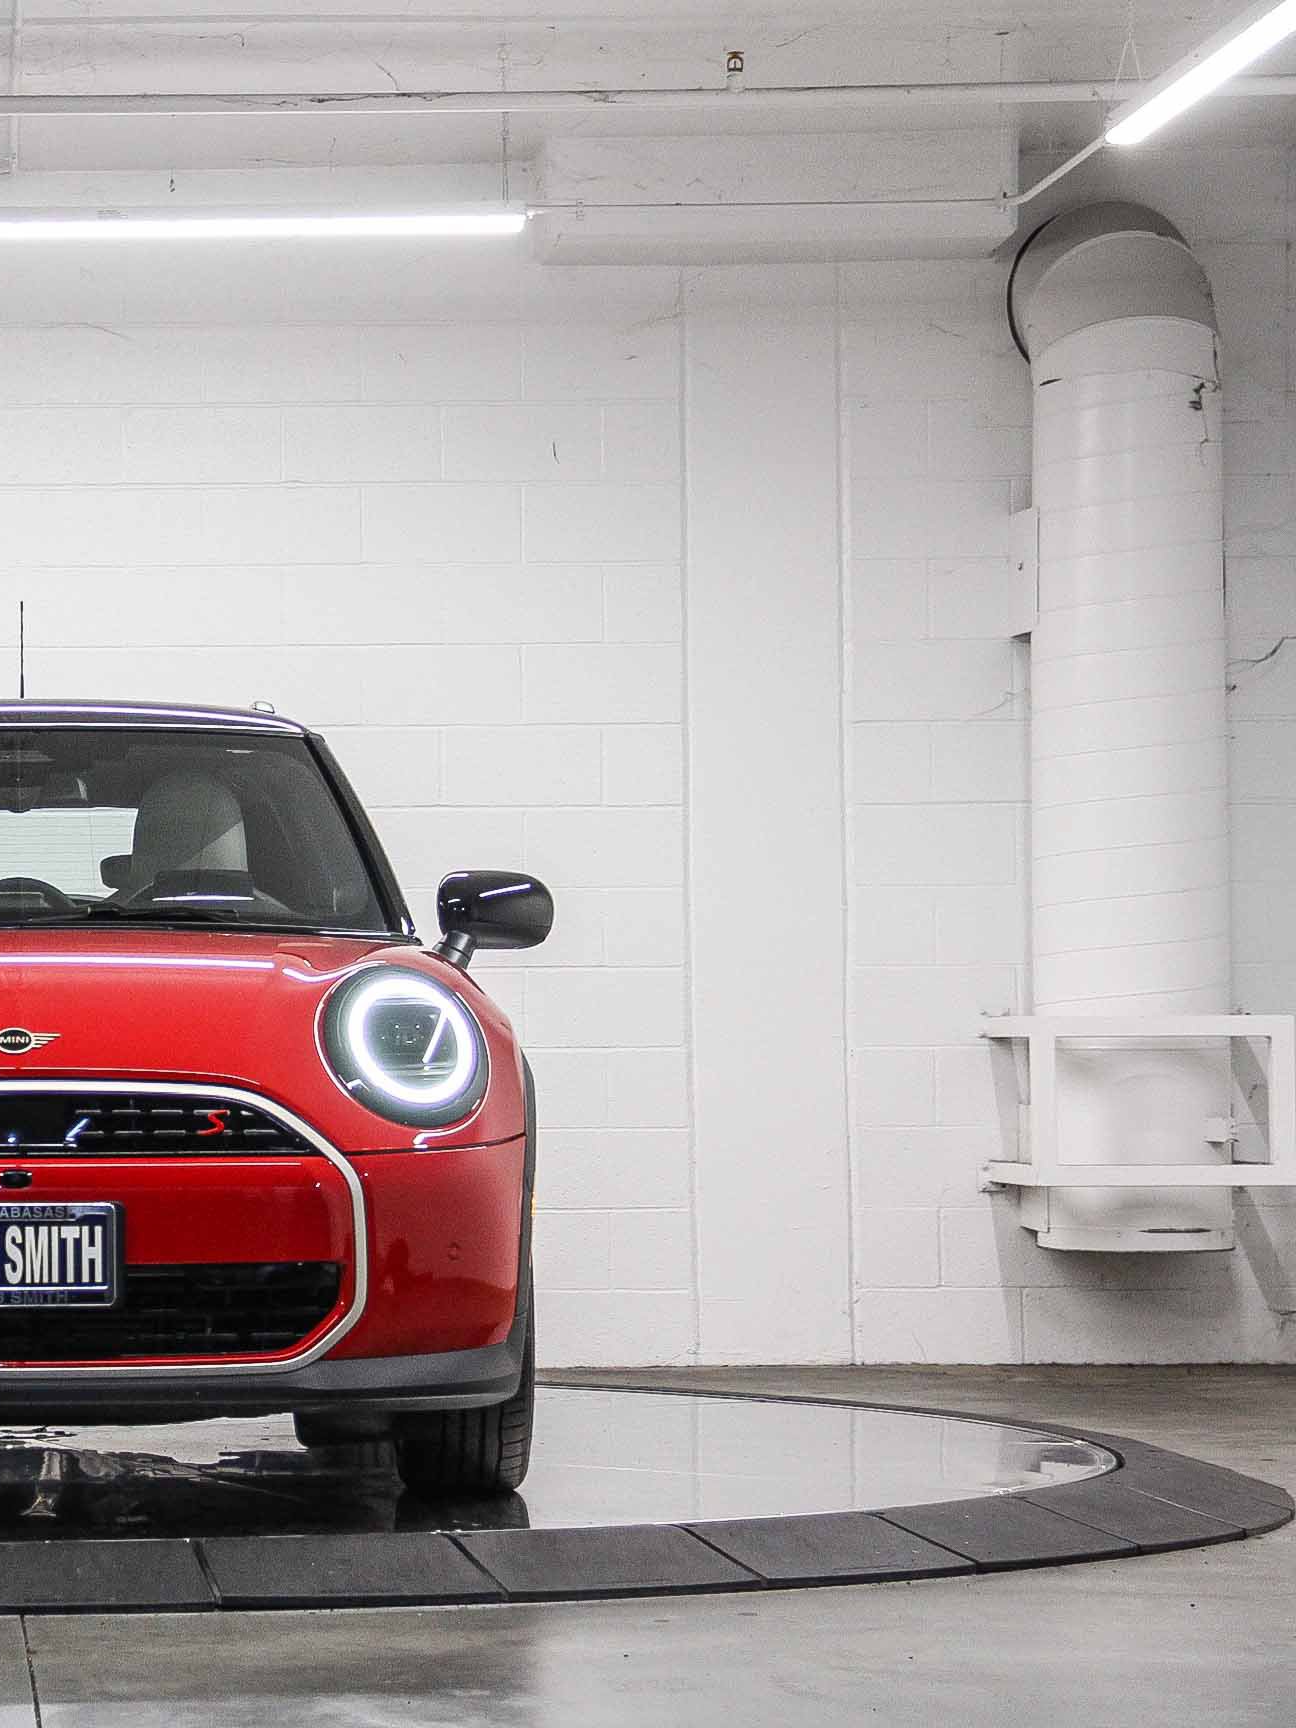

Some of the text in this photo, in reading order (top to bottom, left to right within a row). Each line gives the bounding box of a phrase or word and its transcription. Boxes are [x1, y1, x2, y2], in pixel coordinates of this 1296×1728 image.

[0, 1036, 30, 1044] MINI
[195, 1109, 228, 1136] S
[4, 1225, 103, 1285] SMITH
[10, 1290, 68, 1304] SMITH
